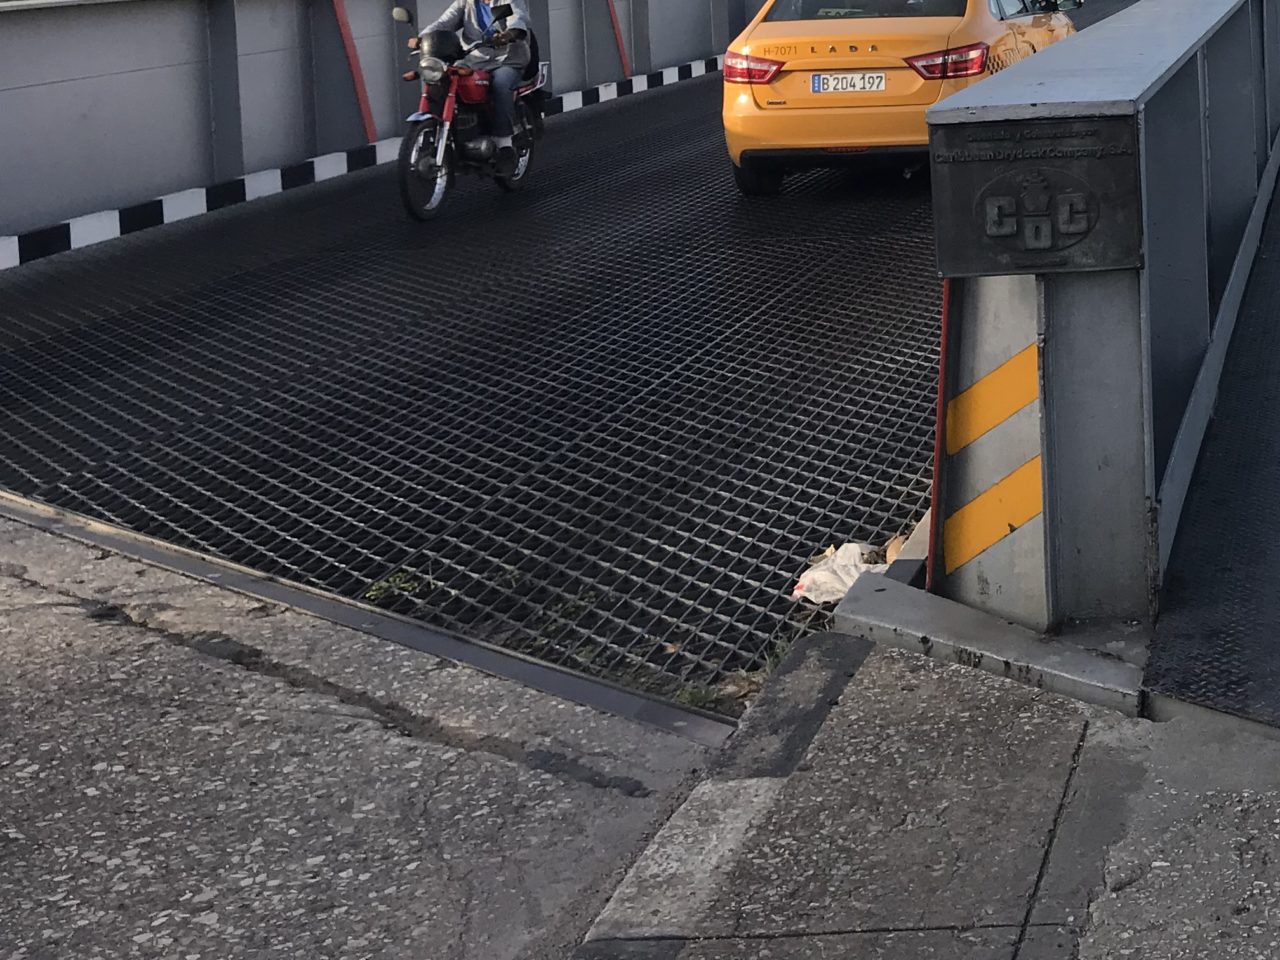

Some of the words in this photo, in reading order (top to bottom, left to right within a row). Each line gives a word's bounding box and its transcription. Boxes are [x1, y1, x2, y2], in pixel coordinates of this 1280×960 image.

[763, 46, 798, 56] H-7071
[811, 45, 878, 53] LADA
[821, 77, 829, 91] B
[833, 76, 856, 91] 204
[859, 75, 883, 90] 197
